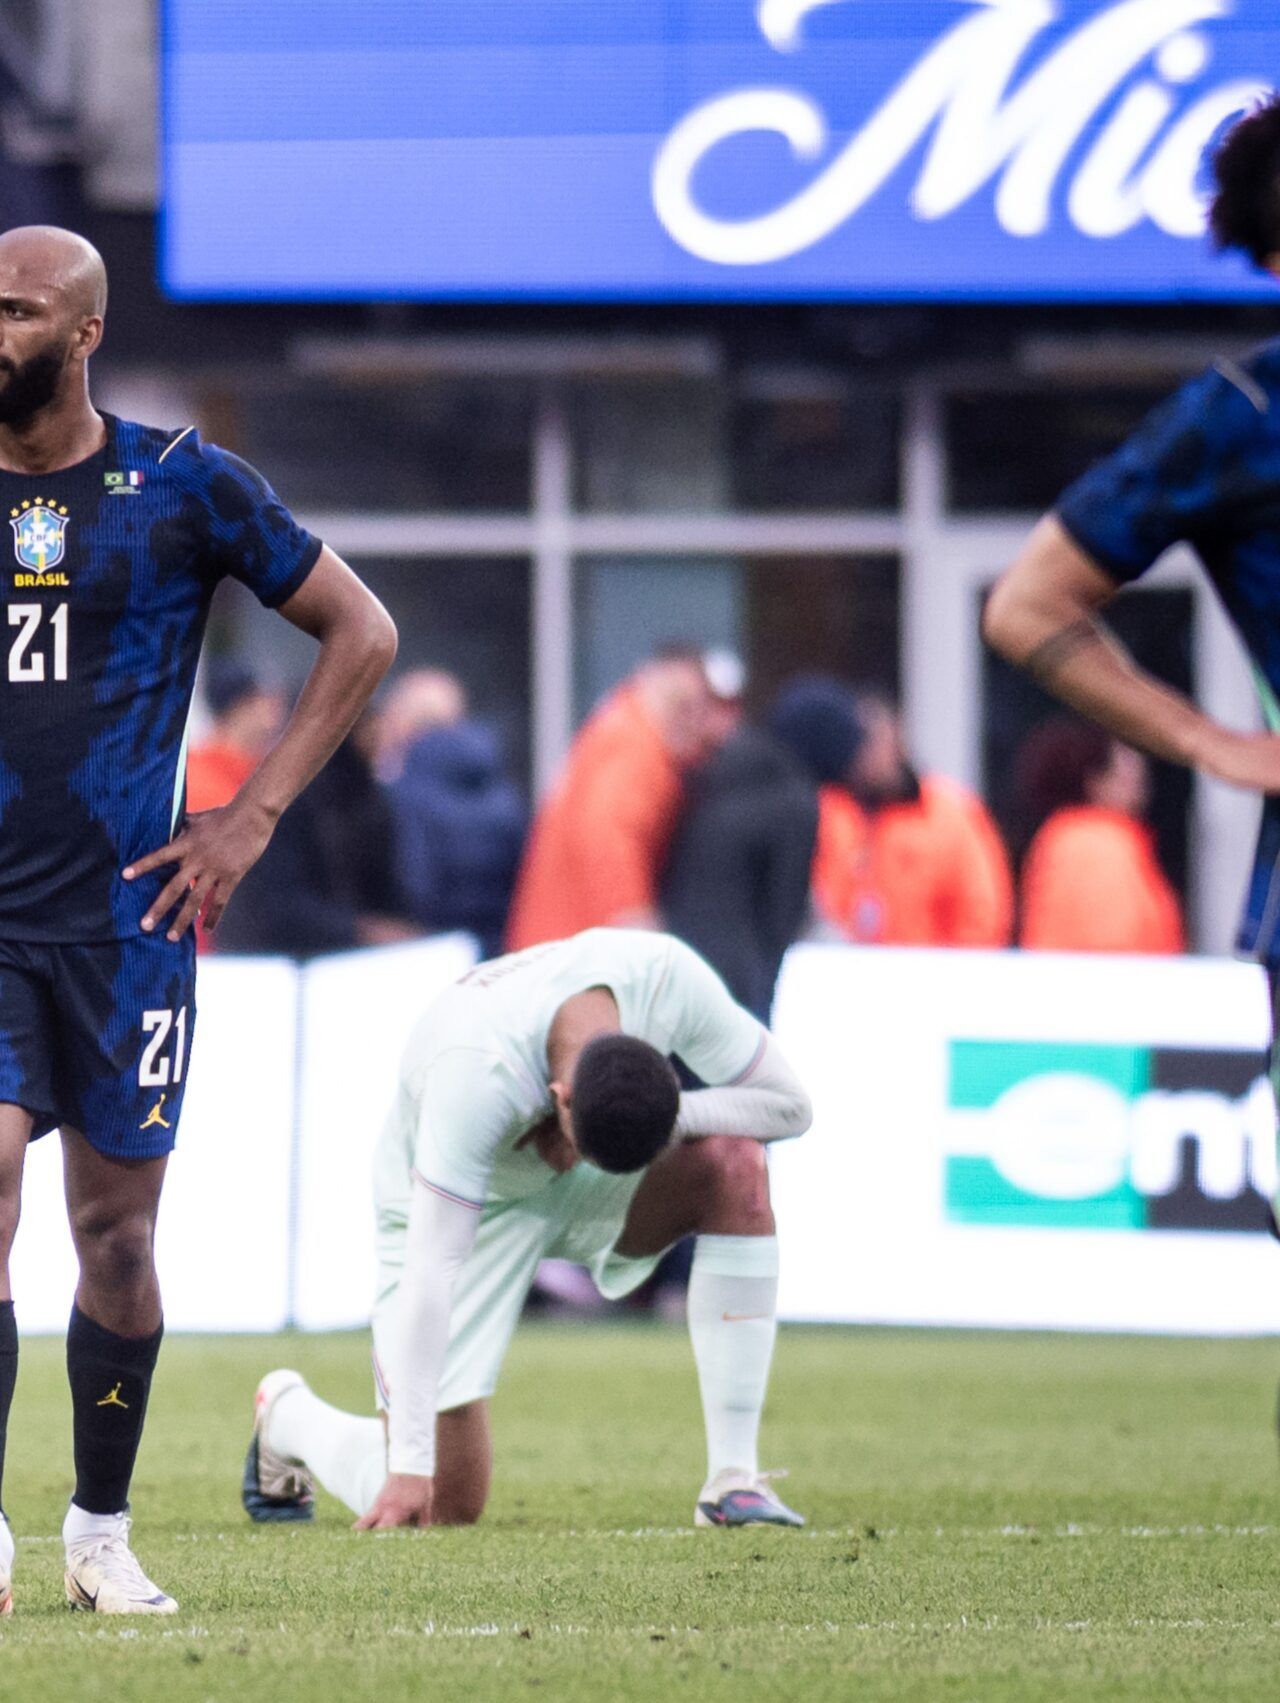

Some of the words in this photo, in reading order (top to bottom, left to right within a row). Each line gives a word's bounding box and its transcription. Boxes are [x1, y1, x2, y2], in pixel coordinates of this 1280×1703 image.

[14, 573, 70, 587] BRASIL
[7, 602, 68, 682] 21
[138, 1006, 187, 1087] 21
